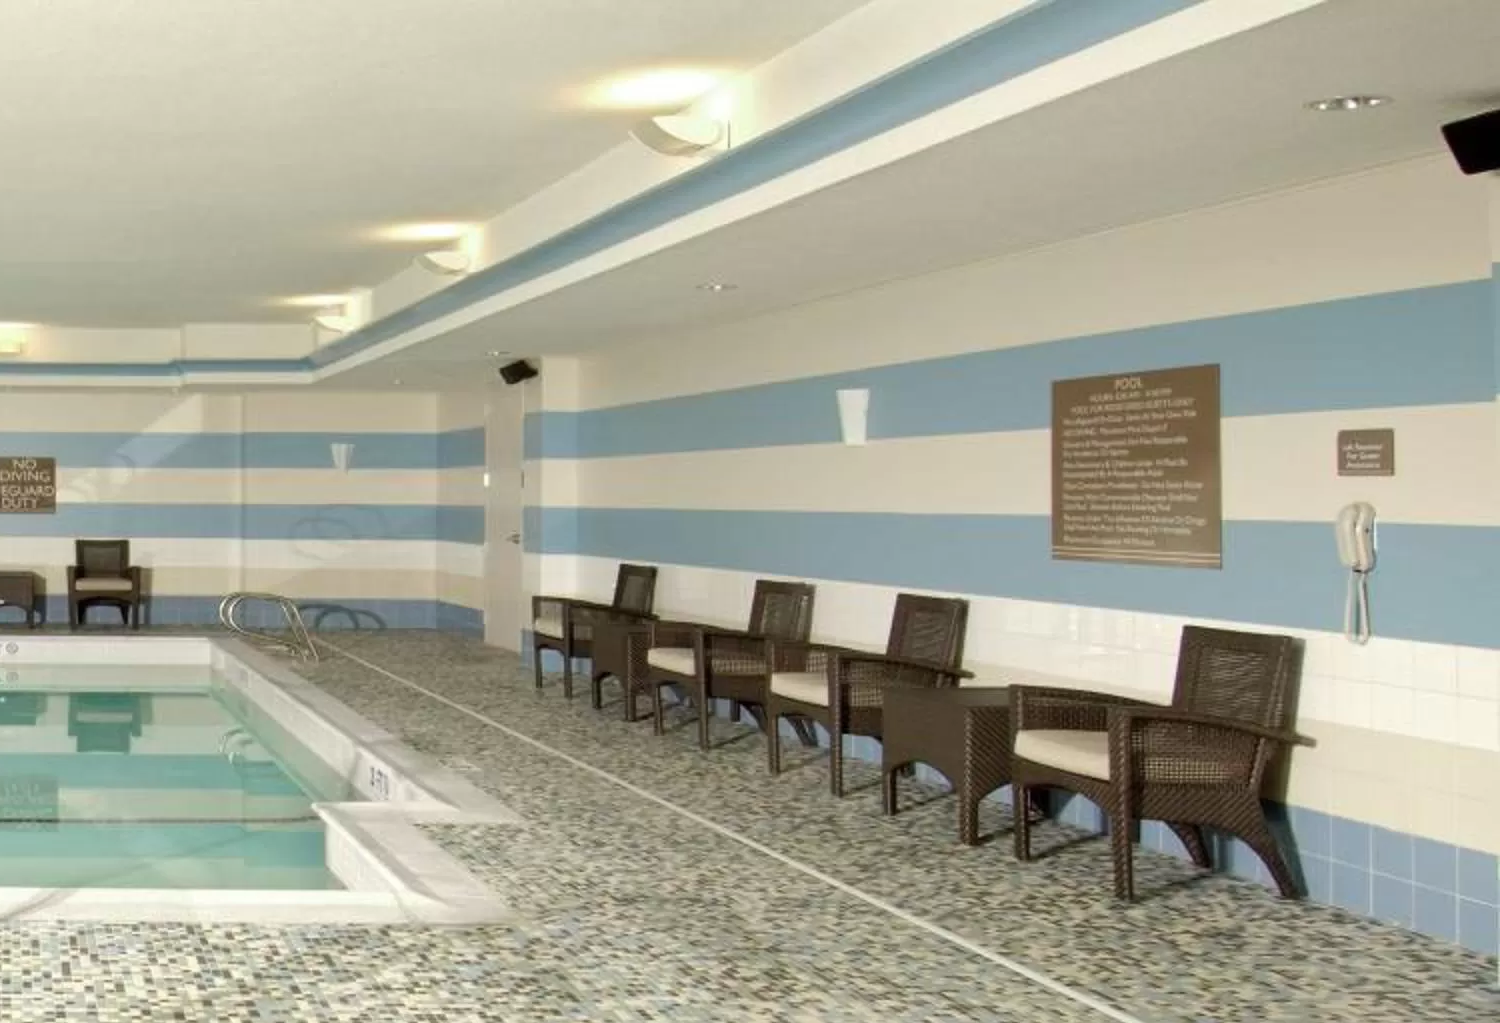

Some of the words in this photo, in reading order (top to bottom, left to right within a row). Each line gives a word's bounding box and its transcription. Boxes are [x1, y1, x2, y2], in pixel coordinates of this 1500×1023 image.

[13, 459, 37, 470] NO
[0, 470, 51, 482] DIVING
[1, 498, 38, 509] DUTY
